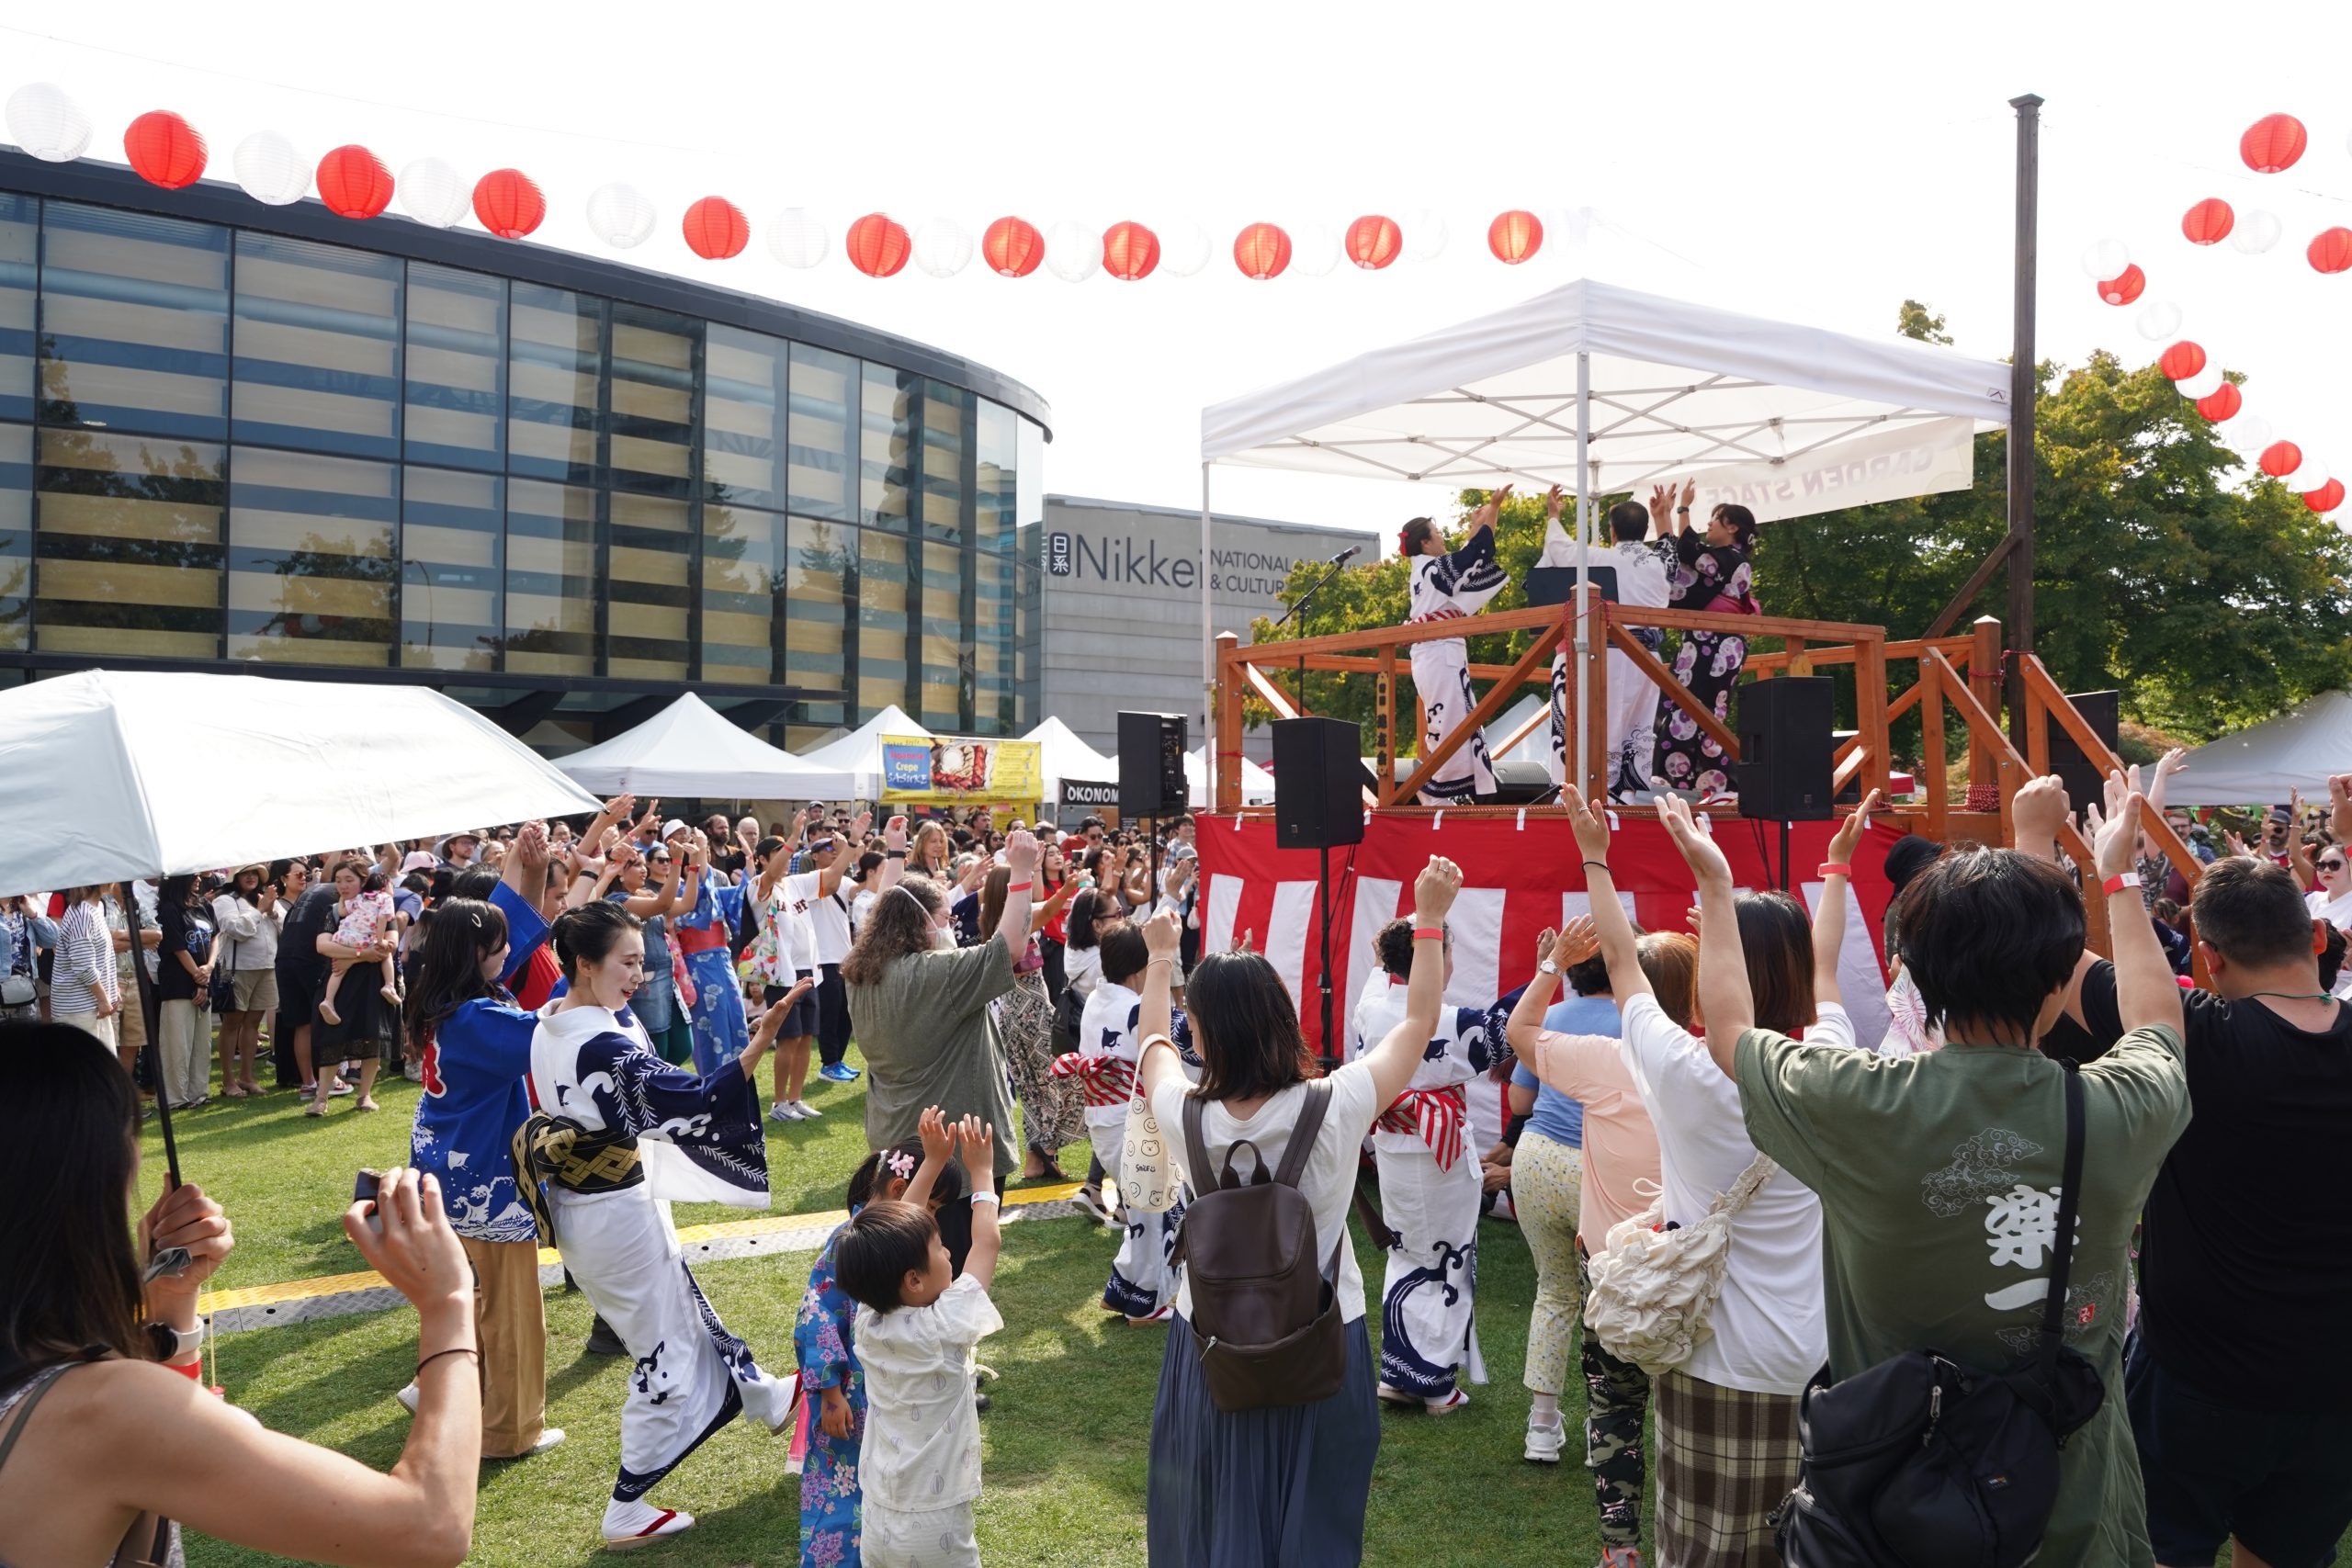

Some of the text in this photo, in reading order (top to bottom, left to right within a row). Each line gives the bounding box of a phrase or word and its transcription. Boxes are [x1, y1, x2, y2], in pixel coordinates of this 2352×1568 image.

[1052, 536, 1069, 573] 日系
[1076, 533, 1203, 590] Nikkei
[1210, 549, 1292, 572] NATIONAL
[1211, 574, 1221, 590] &
[896, 761, 919, 773] Crepe
